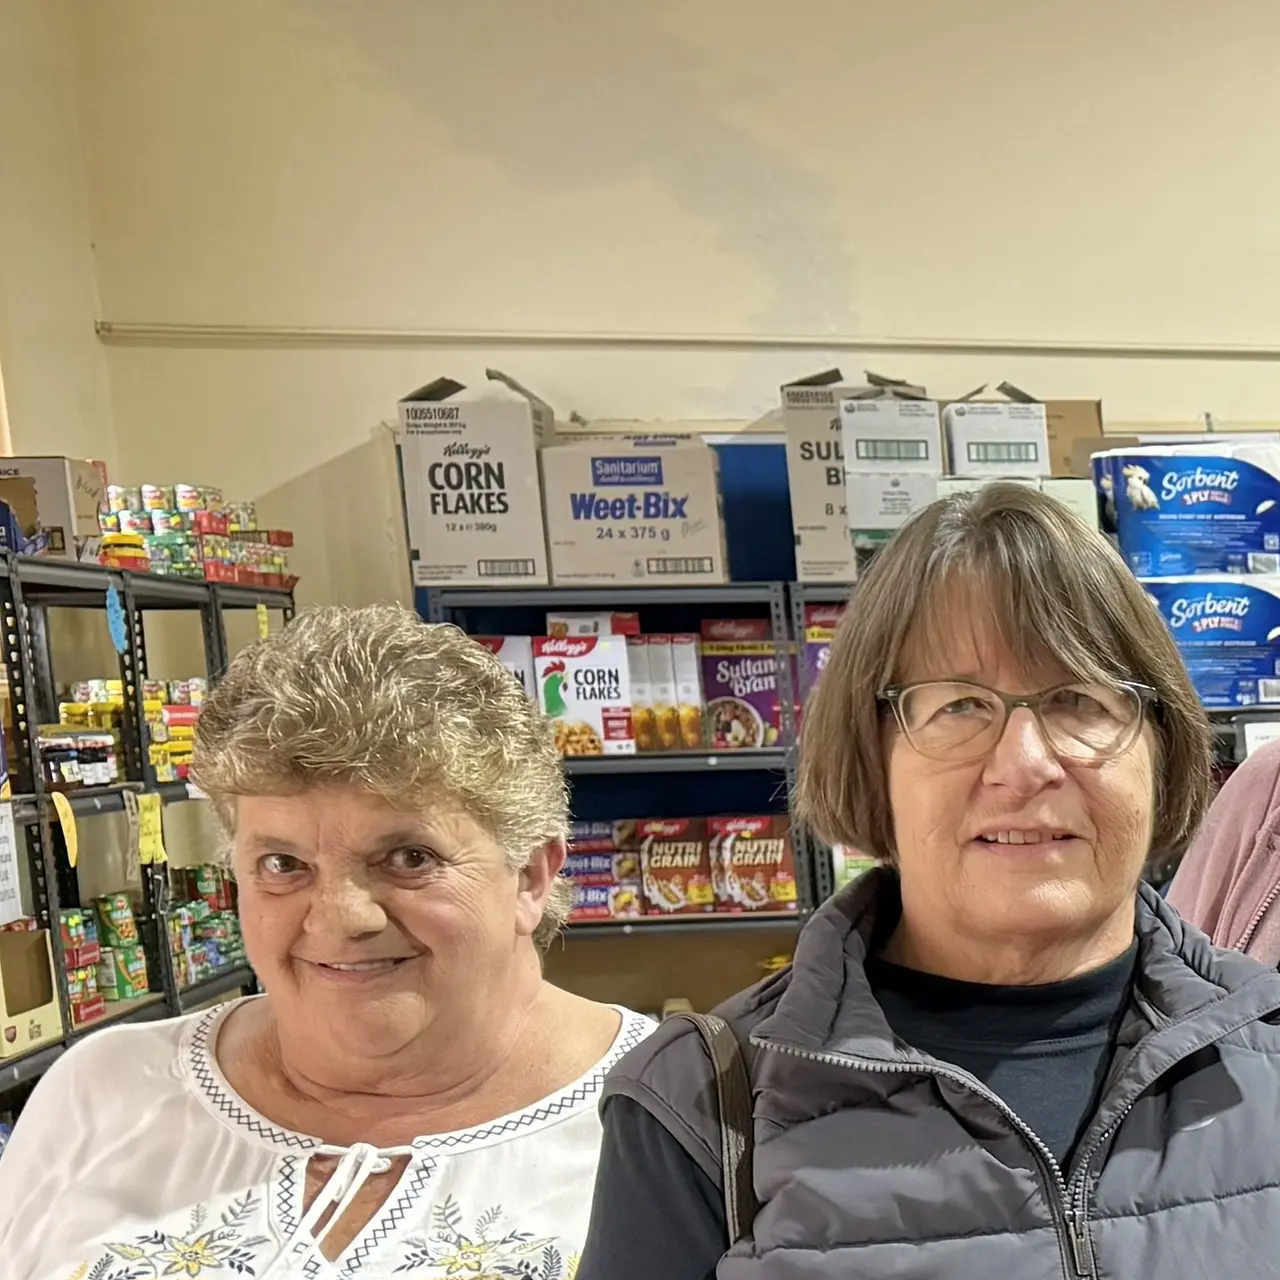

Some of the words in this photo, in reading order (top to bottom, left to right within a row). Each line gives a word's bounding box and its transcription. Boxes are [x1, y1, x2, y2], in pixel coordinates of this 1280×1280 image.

[443, 441, 491, 459] Kellogg's
[428, 461, 506, 490] CORN
[595, 460, 660, 475] Sanitarium
[1161, 467, 1240, 501] Sorbent
[430, 492, 509, 515] FLAKES
[570, 491, 689, 520] Weet-Bix
[596, 527, 613, 539] 24
[617, 529, 627, 538] x
[630, 526, 656, 539] 375
[661, 529, 670, 541] g
[1170, 592, 1249, 628] Sorbent
[541, 638, 588, 656] Kellogg's
[574, 668, 620, 687] CORN
[729, 674, 776, 697] Bran
[576, 686, 621, 700] FLAKES
[652, 842, 702, 856] NUTRI
[735, 839, 785, 854] NUTRI
[650, 854, 701, 868] GRAIN
[733, 852, 783, 866] GRAIN
